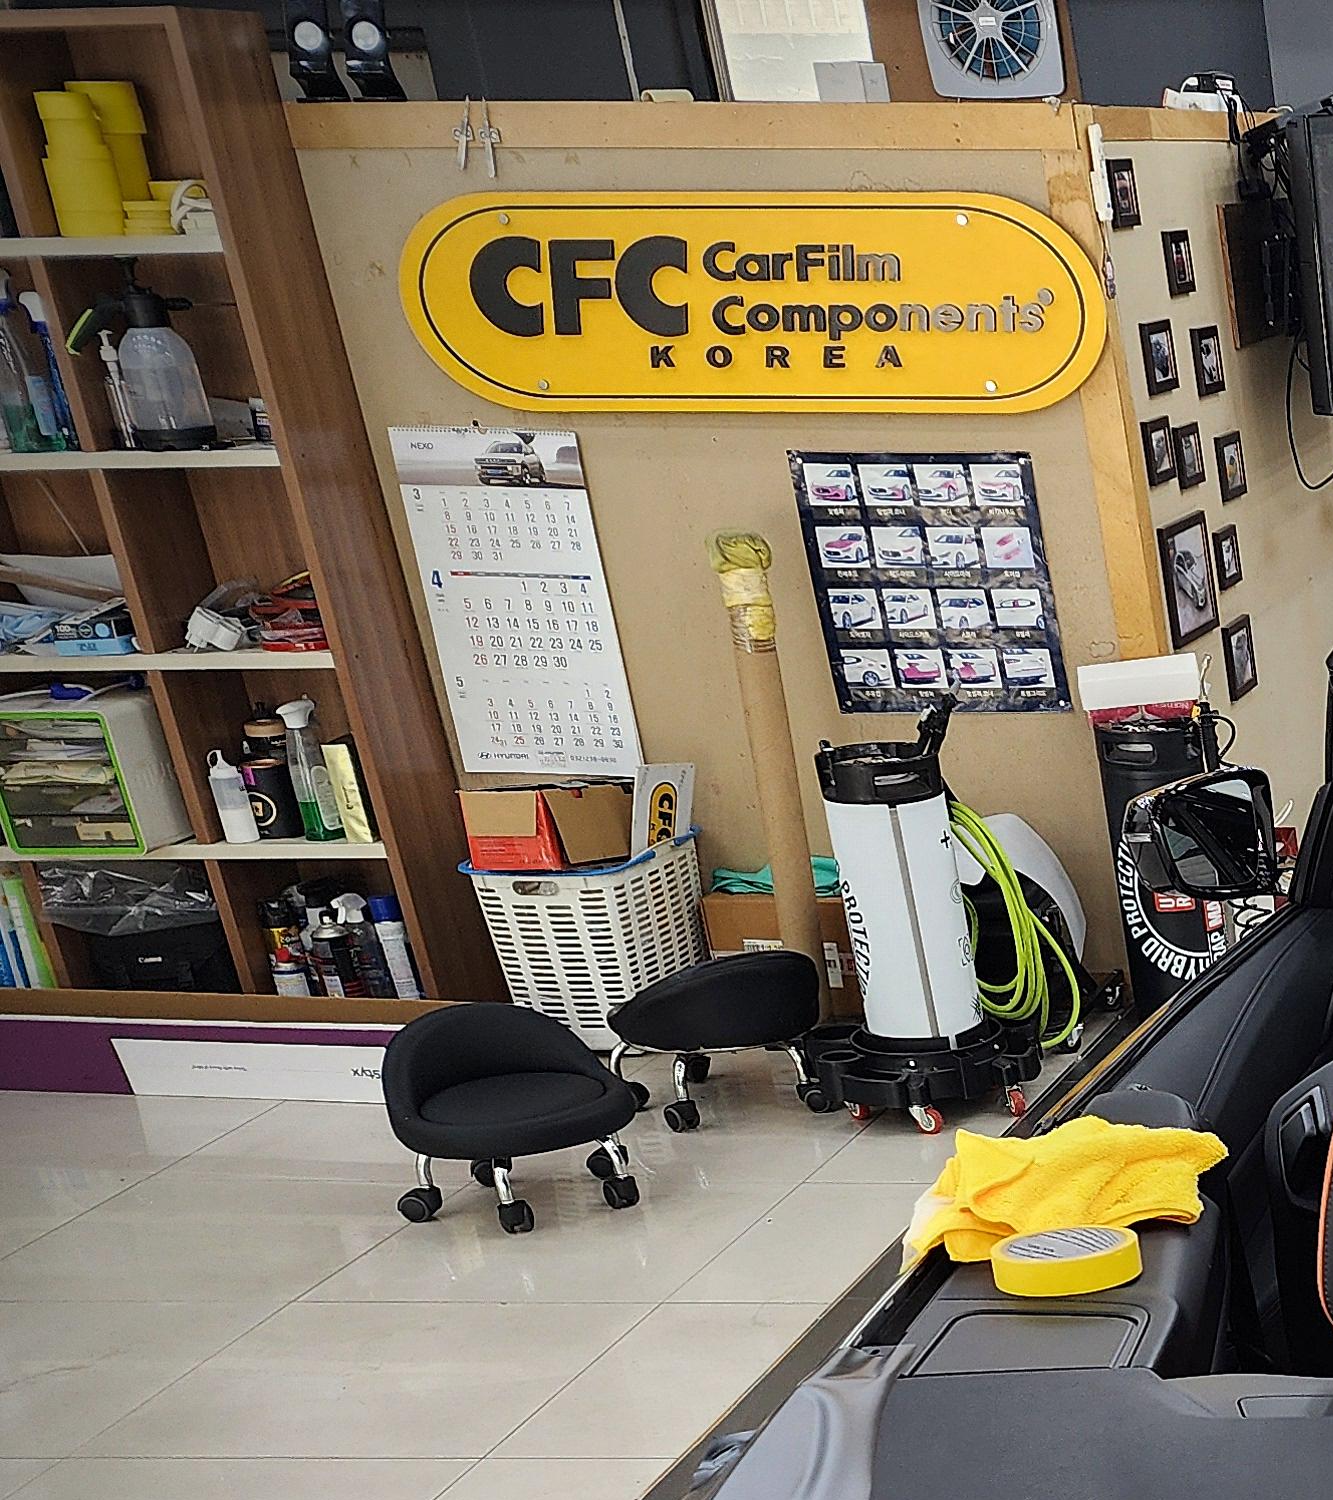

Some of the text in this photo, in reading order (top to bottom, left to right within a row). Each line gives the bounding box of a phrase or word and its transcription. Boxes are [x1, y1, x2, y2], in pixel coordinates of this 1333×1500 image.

[702, 241, 902, 283] CarFilm
[469, 235, 688, 338] CFC
[712, 294, 1046, 342] Components
[651, 345, 903, 370] KOREA
[410, 442, 434, 450] NEXO
[412, 488, 421, 500] 3
[485, 511, 495, 522] 10
[506, 512, 515, 522] 11
[526, 513, 536, 523] 12
[546, 514, 556, 524] 13
[566, 514, 576, 524] 14
[446, 524, 457, 534] 15
[487, 525, 497, 535] 17
[508, 525, 518, 536] 18
[528, 526, 538, 536] 19
[548, 526, 559, 537] 20
[568, 527, 578, 538] 21
[448, 537, 459, 547] 22
[469, 537, 481, 547] 23
[489, 538, 501, 548] 24
[510, 538, 521, 549] 25
[550, 539, 561, 550] 27
[452, 550, 503, 561] 29 30 31
[431, 570, 443, 588] 4
[521, 581, 587, 594] 1 2 3 4
[463, 598, 594, 613] 5 6 7 8 9 10 11
[466, 617, 599, 632] 12 13 14 15 16 17 18
[470, 636, 602, 651] 19 20 21 22 23 24 25
[473, 654, 568, 668] 26 27 28 29 30
[456, 676, 464, 688] 5
[489, 710, 499, 719] 10
[509, 711, 519, 720] 11
[529, 712, 539, 721] 12
[549, 712, 559, 722] 13
[569, 712, 580, 722] 14
[588, 713, 599, 723] 15
[491, 723, 501, 732] 17
[532, 724, 542, 733] 19
[551, 725, 562, 734] 20
[571, 725, 581, 735] 21
[591, 726, 602, 735] 22
[610, 727, 621, 736] 23
[514, 736, 525, 745] 25
[553, 737, 563, 746] 27
[594, 738, 604, 748] 29
[1117, 837, 1148, 939] PROTECTI
